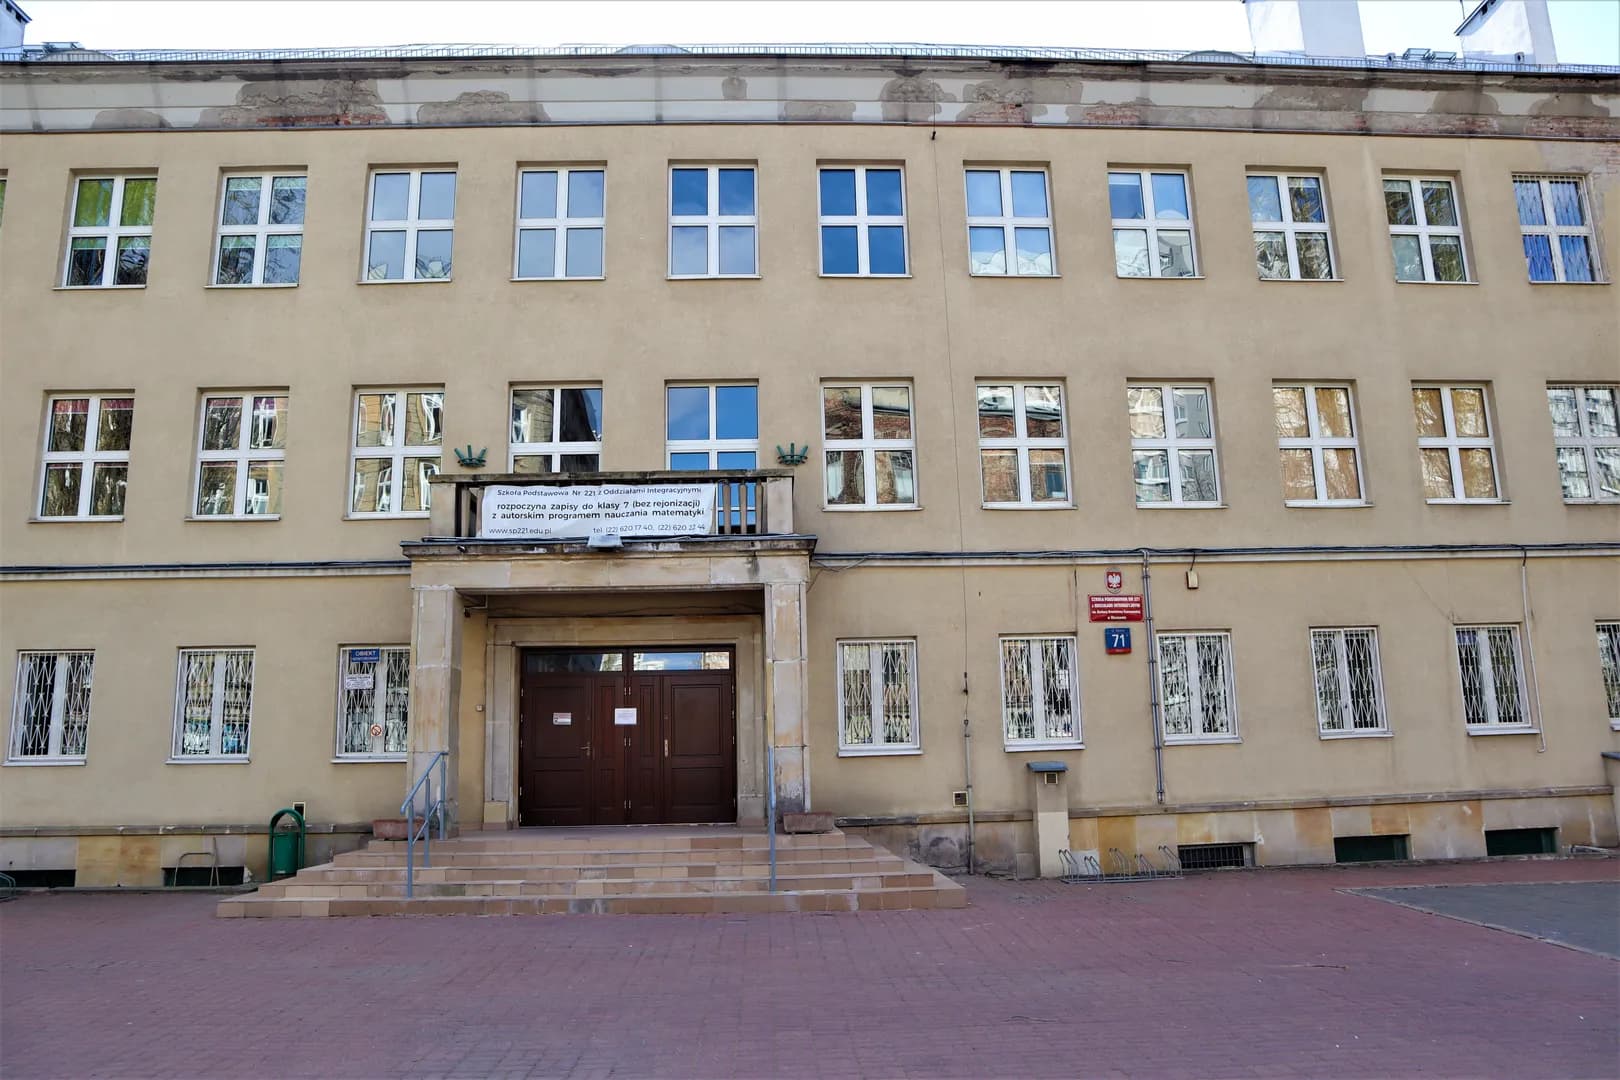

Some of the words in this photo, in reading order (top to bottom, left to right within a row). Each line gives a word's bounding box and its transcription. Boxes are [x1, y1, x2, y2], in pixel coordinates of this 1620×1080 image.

[523, 489, 569, 497] Podstawowa
[603, 487, 646, 495] Oddziałami
[647, 487, 701, 495] Integracyjnymi
[497, 503, 547, 511] rozpoczyna
[550, 502, 578, 511] zapisy
[582, 502, 594, 510] do
[597, 501, 620, 510] klasy
[623, 501, 629, 509] 7
[632, 499, 651, 508] (bez
[653, 499, 701, 508] rejonizacji)
[500, 511, 544, 519] autorskim
[548, 512, 600, 520] programem
[604, 510, 648, 518] nauczania
[652, 508, 704, 517] matematyki
[489, 527, 552, 535] www.sp221.edu.pl
[1112, 634, 1125, 648] 71
